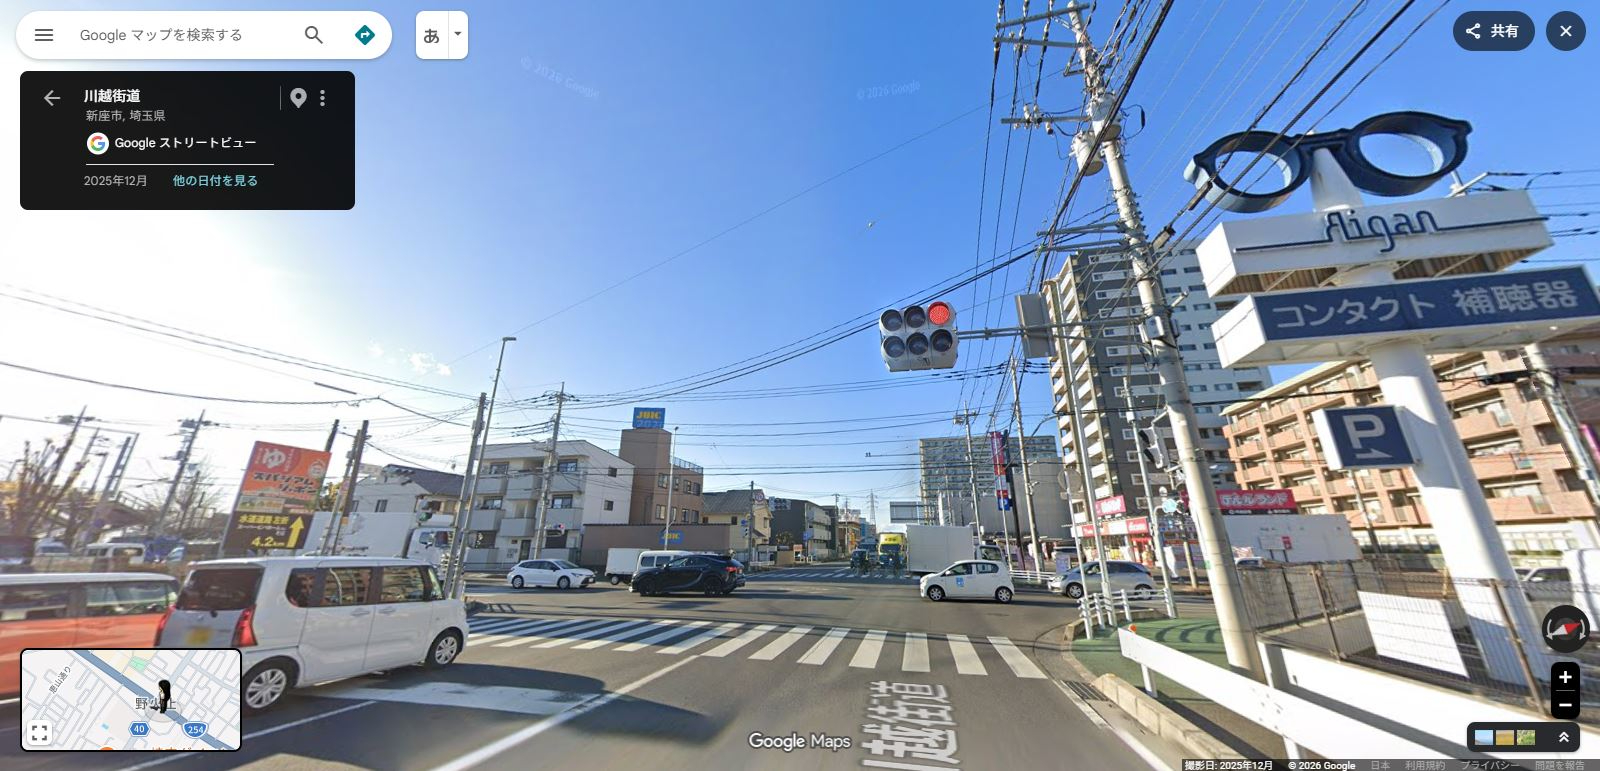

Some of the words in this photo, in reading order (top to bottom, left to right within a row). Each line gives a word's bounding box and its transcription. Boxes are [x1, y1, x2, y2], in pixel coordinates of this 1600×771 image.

[1325, 208, 1441, 253] Aigan
[1272, 294, 1435, 330] コンタクト
[1451, 279, 1579, 316] 補聴器
[1341, 413, 1387, 451] P
[251, 536, 285, 547] 4.2km
